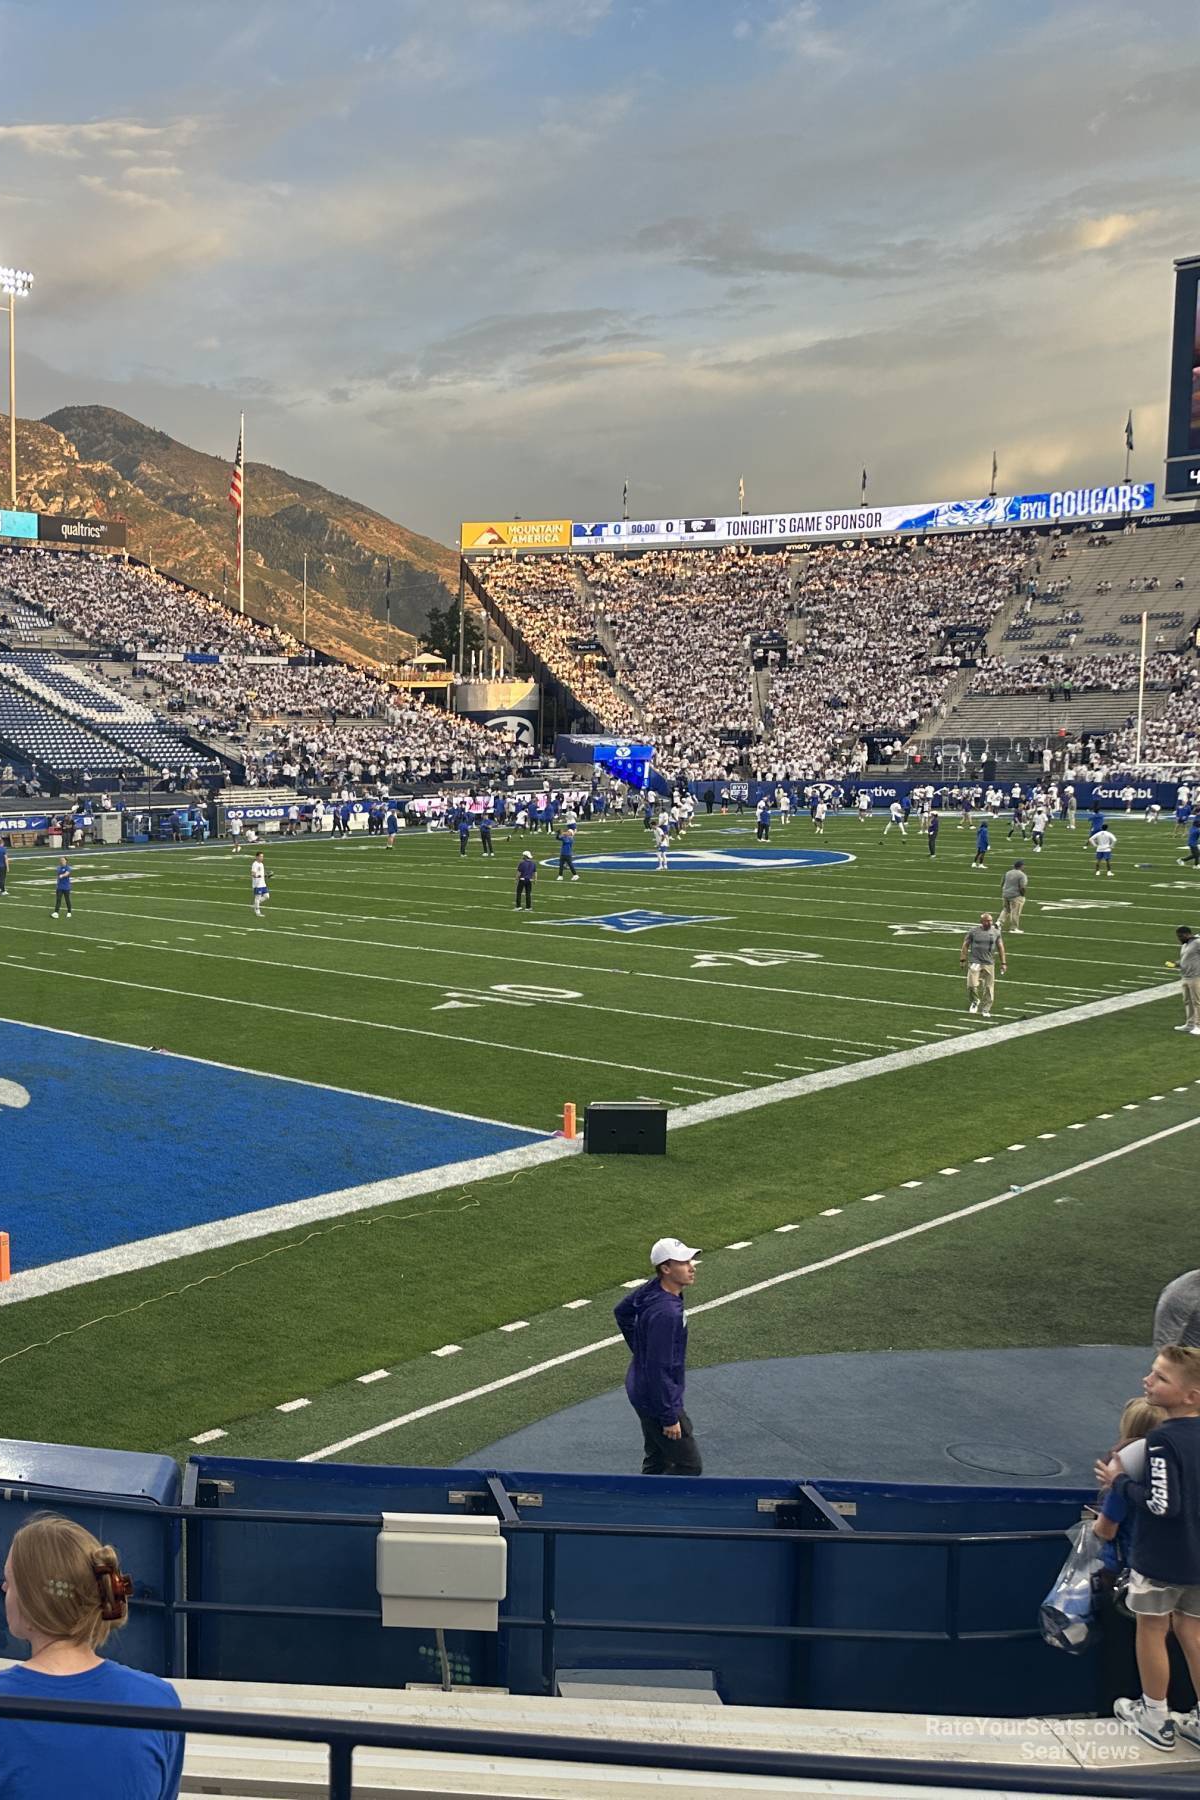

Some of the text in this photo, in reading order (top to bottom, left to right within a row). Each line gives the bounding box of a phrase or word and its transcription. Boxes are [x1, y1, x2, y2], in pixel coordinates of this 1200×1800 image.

[1019, 484, 1146, 521] BYU COUGARS
[507, 524, 564, 536] MOUNTAIN
[727, 512, 882, 536] TONIGHT'S GAME SPONSOR
[510, 534, 560, 545] AMERICA
[227, 808, 284, 820] GO COUGS
